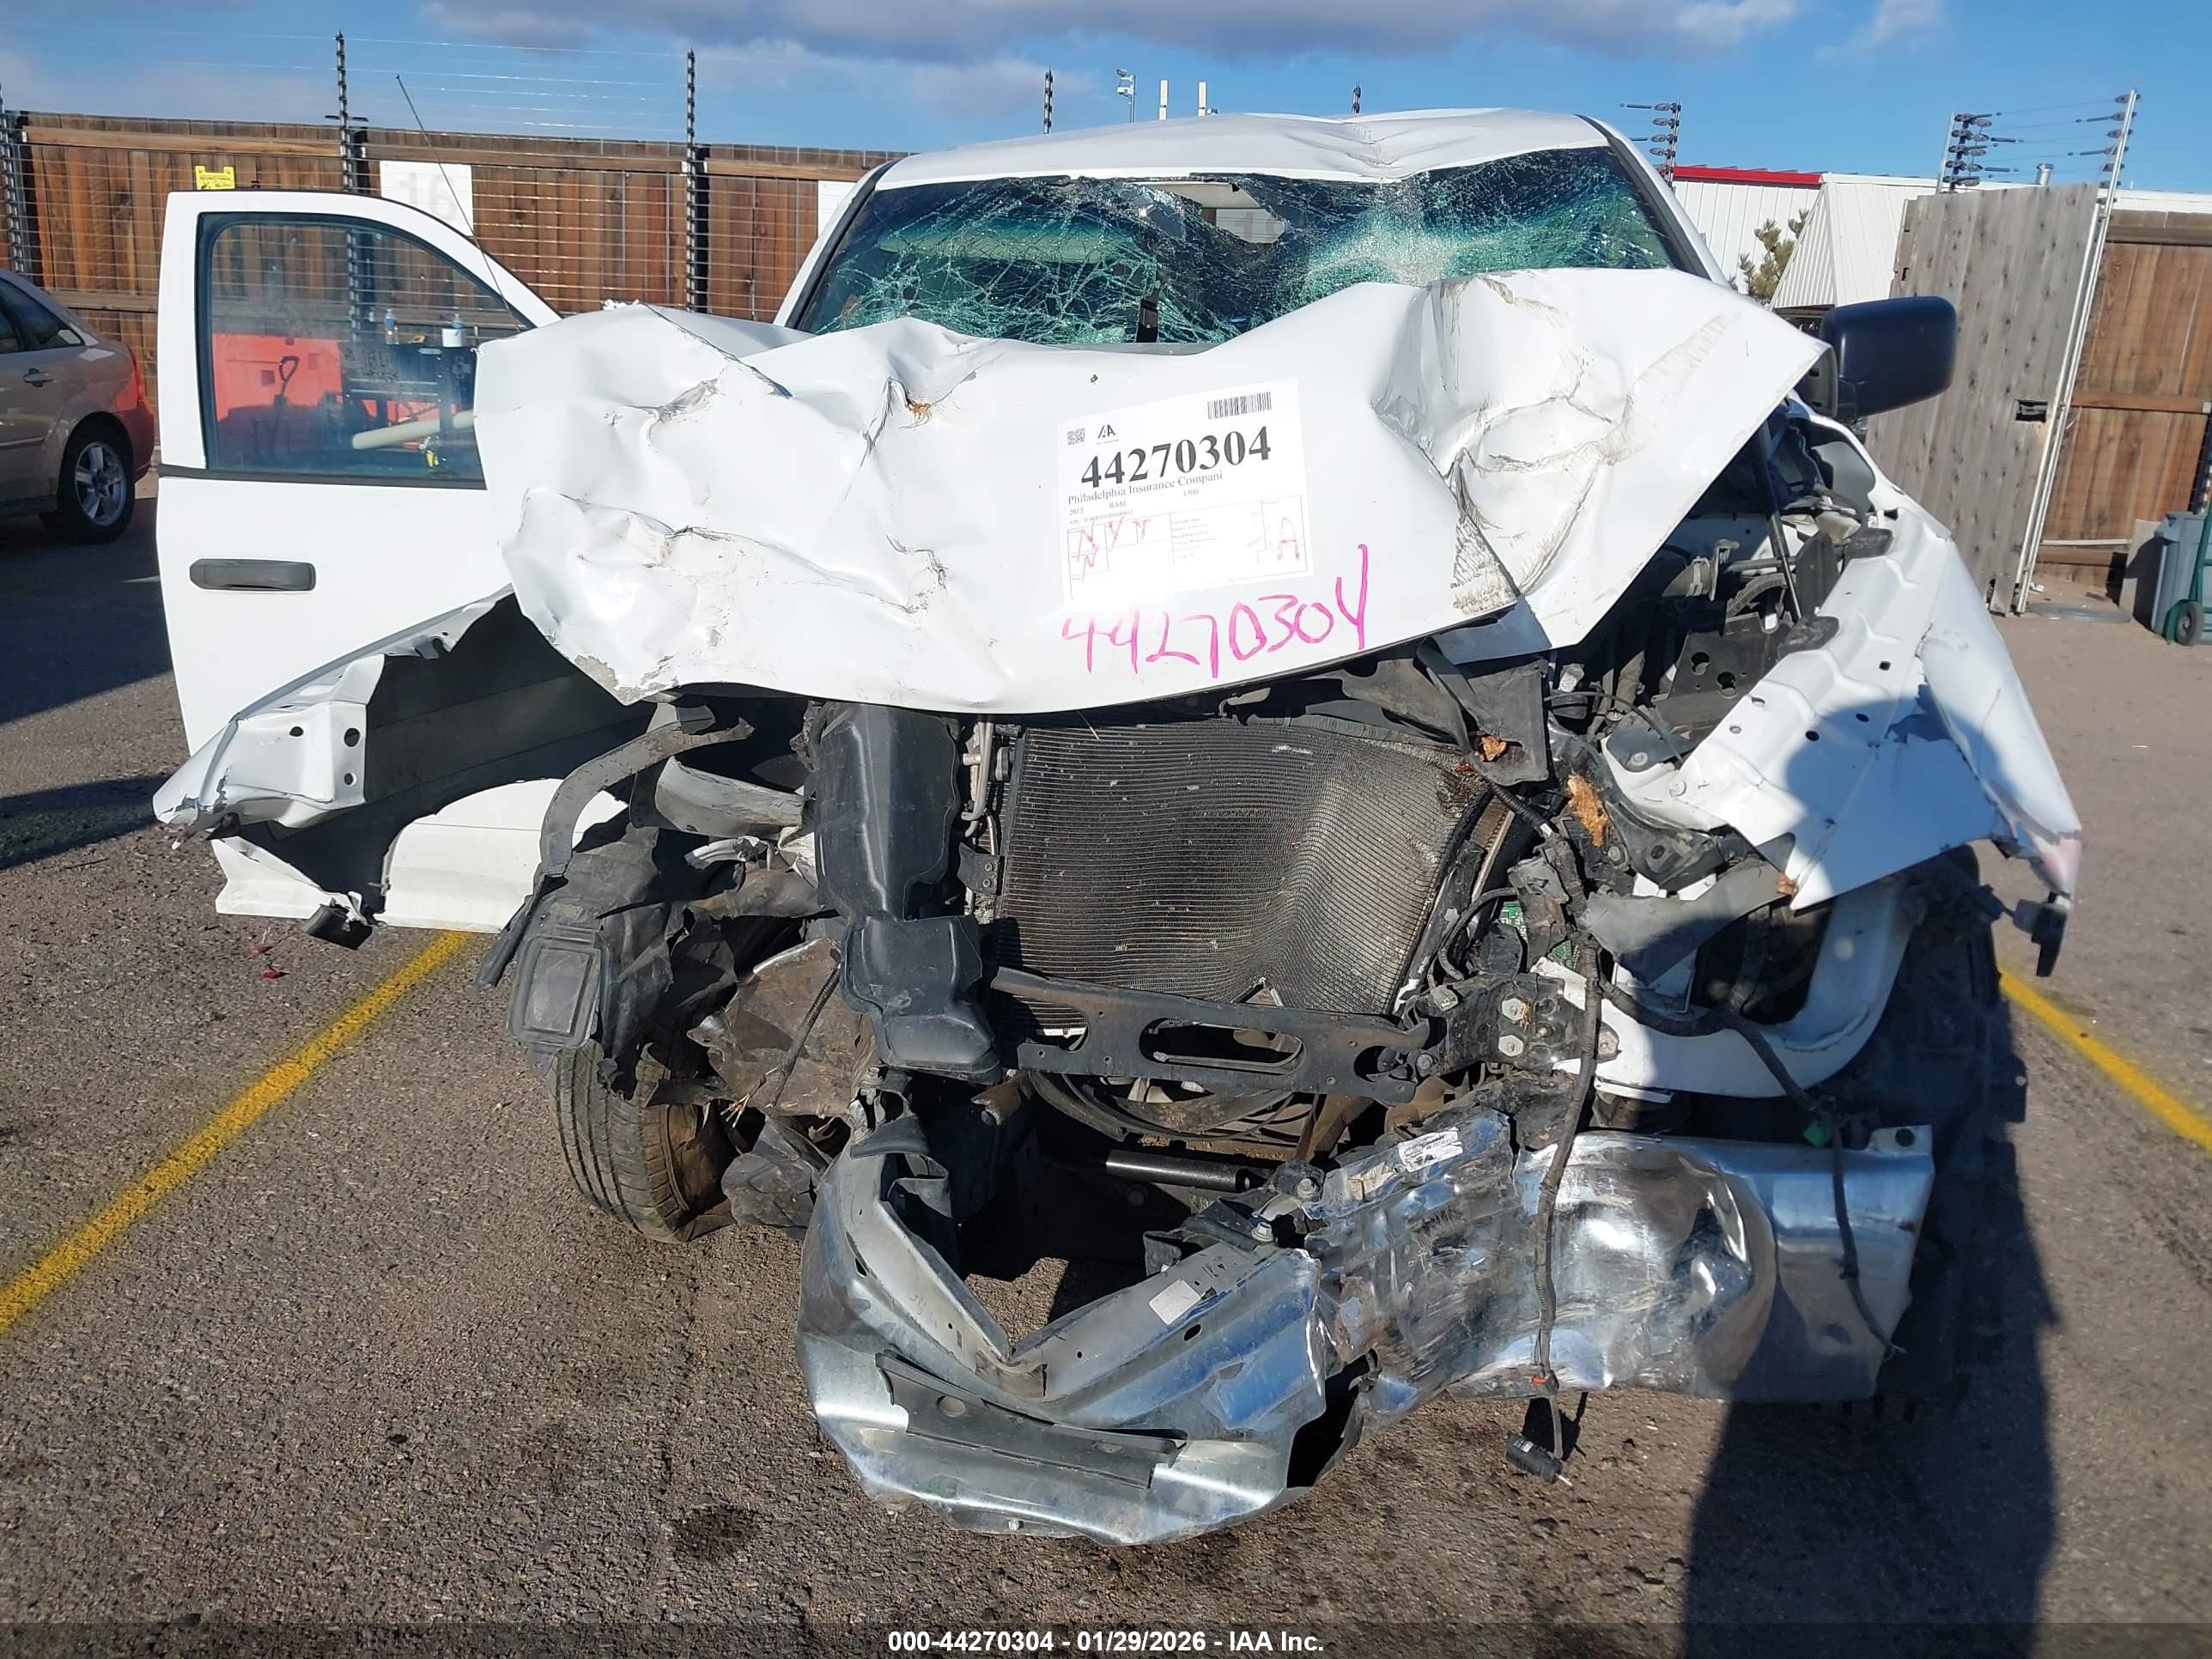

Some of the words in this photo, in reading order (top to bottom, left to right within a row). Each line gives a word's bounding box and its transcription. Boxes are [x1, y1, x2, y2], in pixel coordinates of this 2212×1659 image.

[1081, 426, 1271, 488] 44270304
[1068, 487, 1126, 505] Philadelphia
[1129, 480, 1175, 495] Insurance
[1177, 469, 1223, 486] Compani
[1109, 500, 1127, 509] RAM
